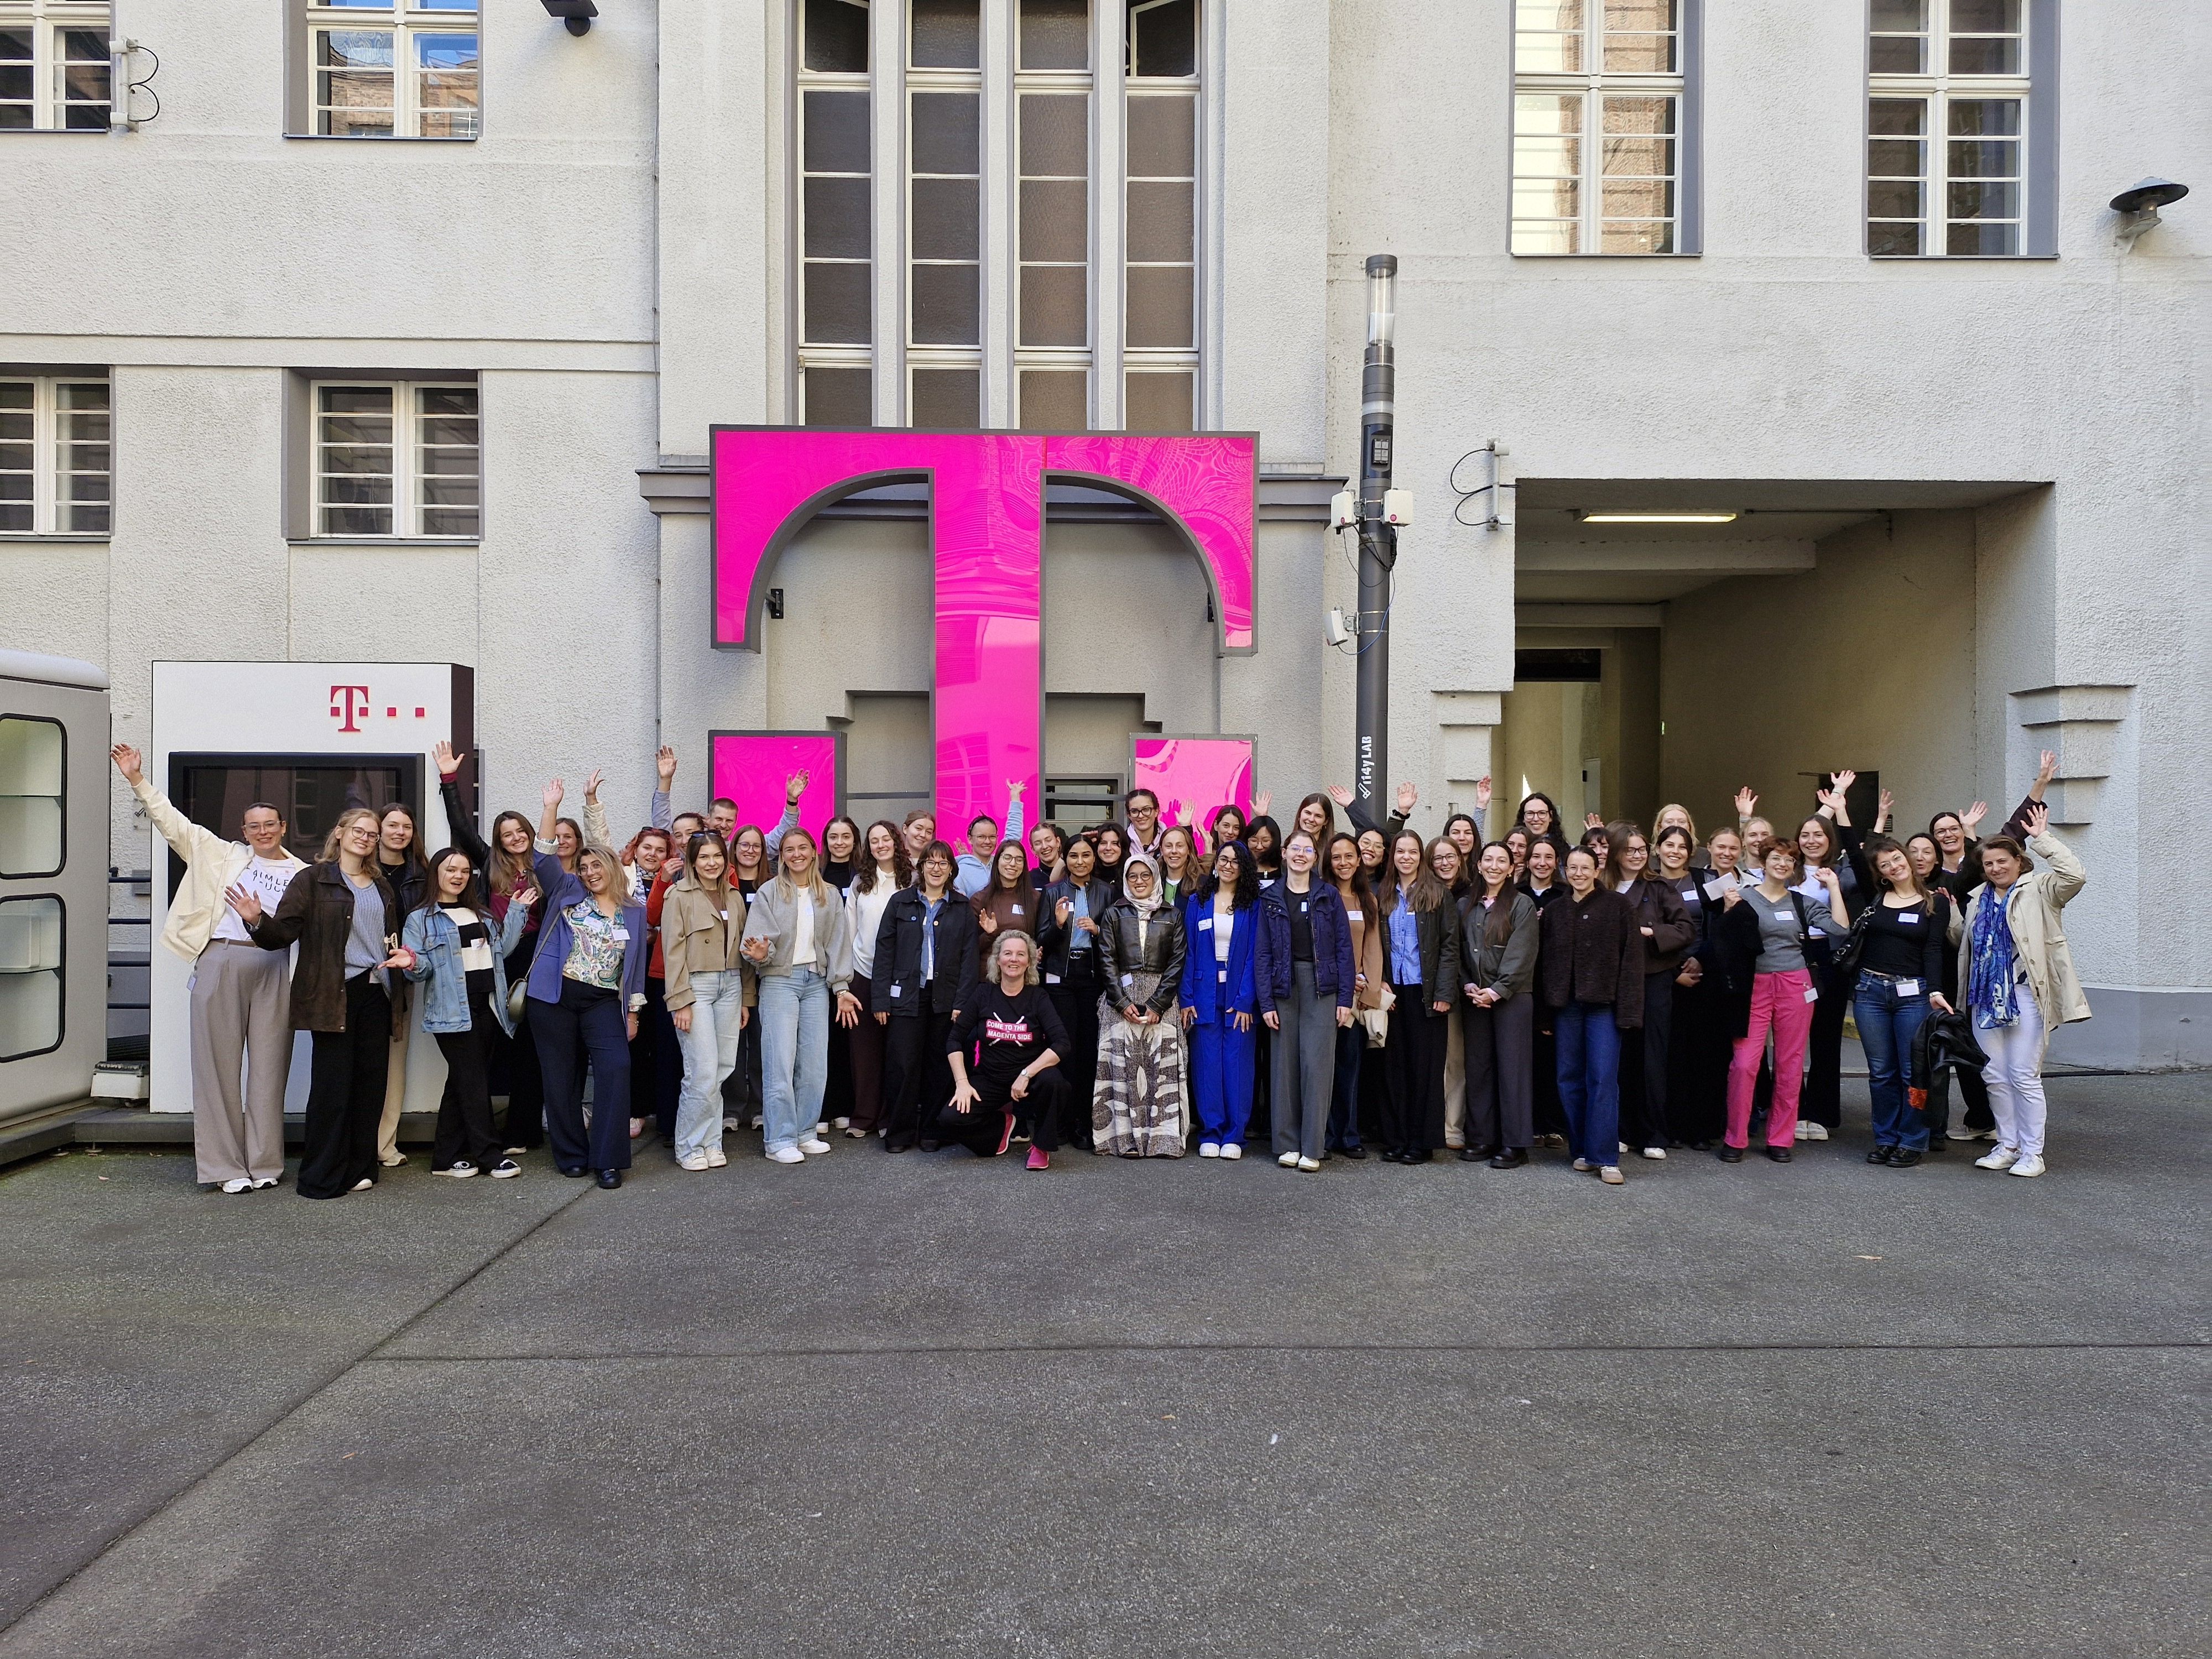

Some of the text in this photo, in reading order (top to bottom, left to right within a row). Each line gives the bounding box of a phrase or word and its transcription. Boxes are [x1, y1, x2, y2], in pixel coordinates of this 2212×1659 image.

[1361, 736, 1371, 758] LAB
[987, 1021, 1004, 1029] COME
[988, 1030, 1016, 1039] MAGENTA
